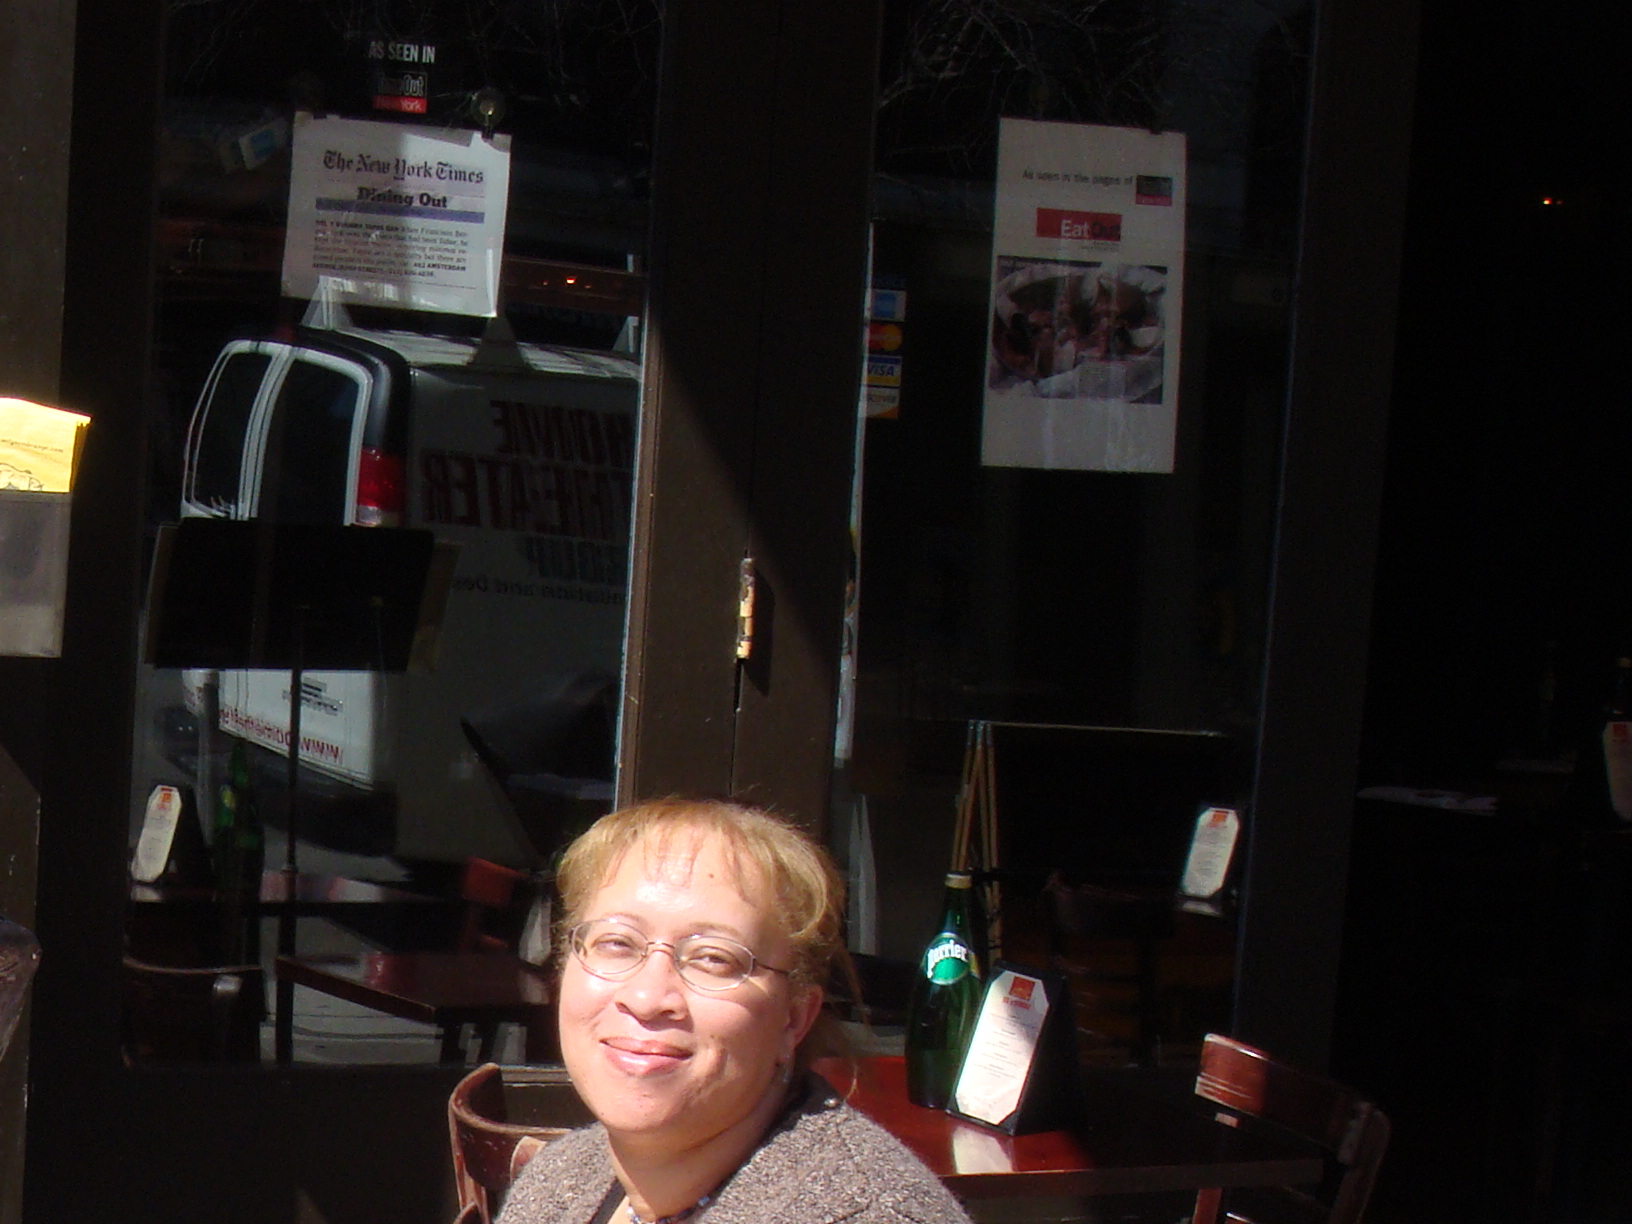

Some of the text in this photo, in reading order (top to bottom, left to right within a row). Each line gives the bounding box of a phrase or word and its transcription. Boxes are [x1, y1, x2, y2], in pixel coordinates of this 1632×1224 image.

[388, 42, 419, 62] SEEN
[422, 45, 436, 63] IN
[323, 150, 484, 184] The New York Times
[1074, 173, 1090, 183] the
[357, 186, 448, 208] Dining Out
[868, 365, 894, 378] VISA
